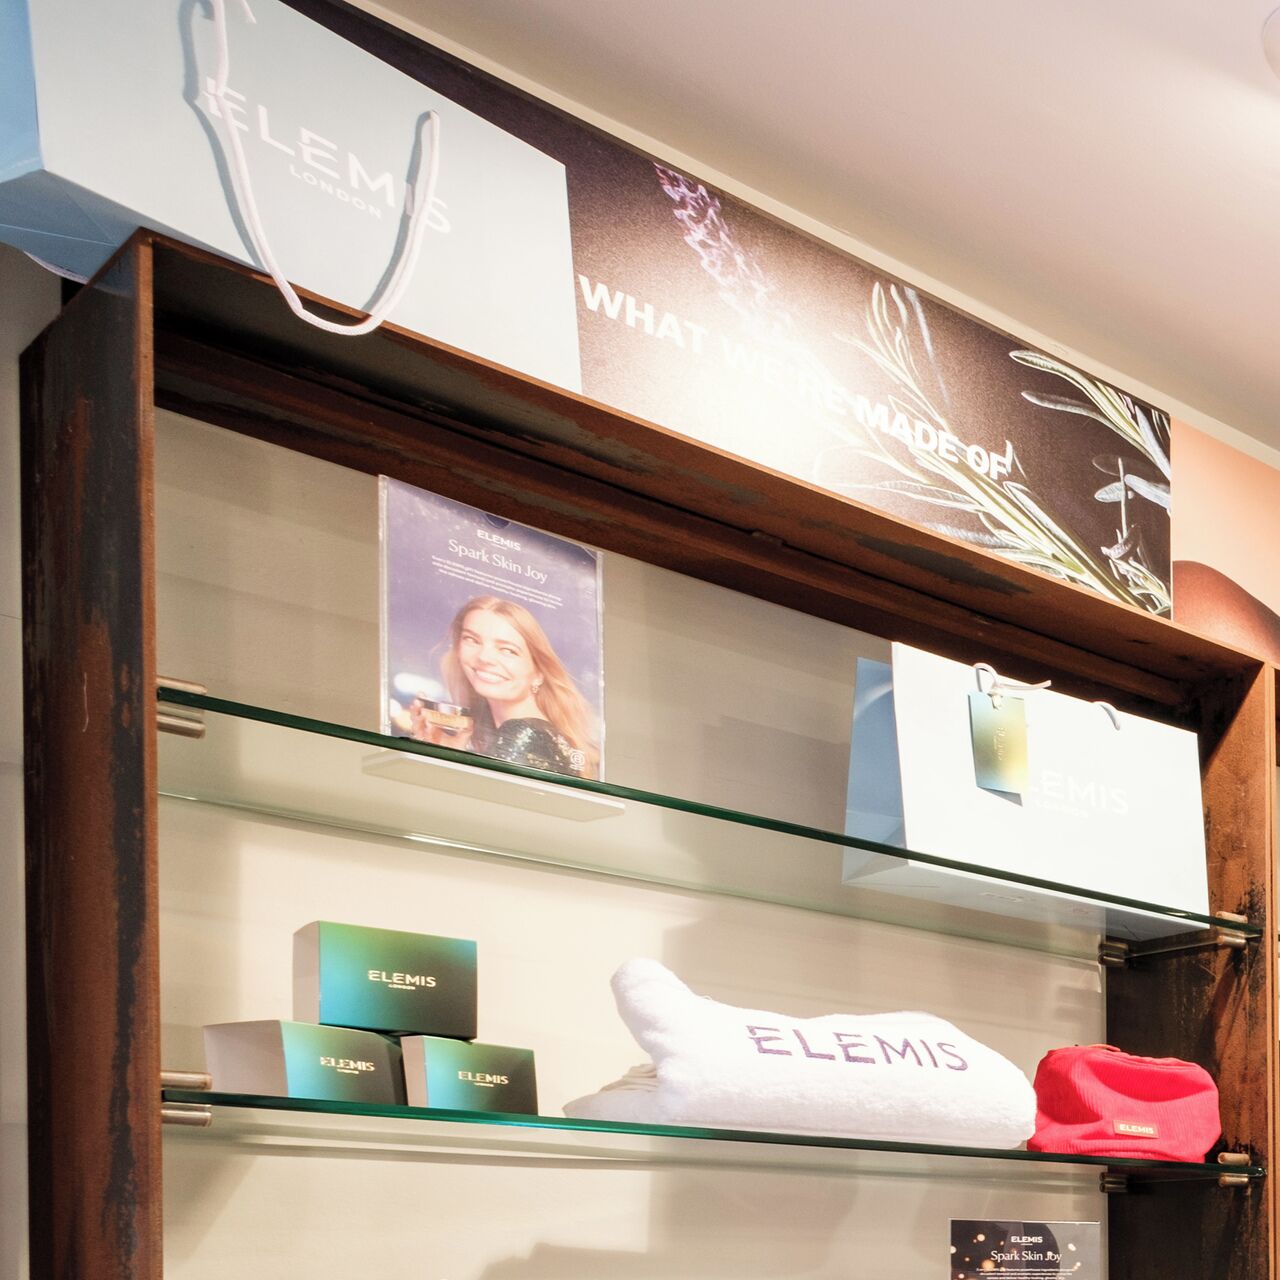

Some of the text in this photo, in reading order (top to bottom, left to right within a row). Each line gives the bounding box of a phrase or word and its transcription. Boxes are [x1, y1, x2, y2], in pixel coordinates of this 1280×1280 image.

[289, 162, 382, 219] LONDON
[579, 275, 708, 354] WHAT
[854, 393, 959, 464] MADE
[966, 443, 1010, 480] OF
[476, 529, 521, 551] ELEMIS
[448, 538, 548, 585] Spark Skin Joy
[368, 969, 436, 987] ELEMIS
[745, 1023, 970, 1073] ELEMIS
[320, 1056, 376, 1071] ELEMIS
[458, 1070, 509, 1085] ELEMIS
[1118, 1122, 1155, 1135] ELEMIS
[991, 1251, 1063, 1264] Spark Skin Joy
